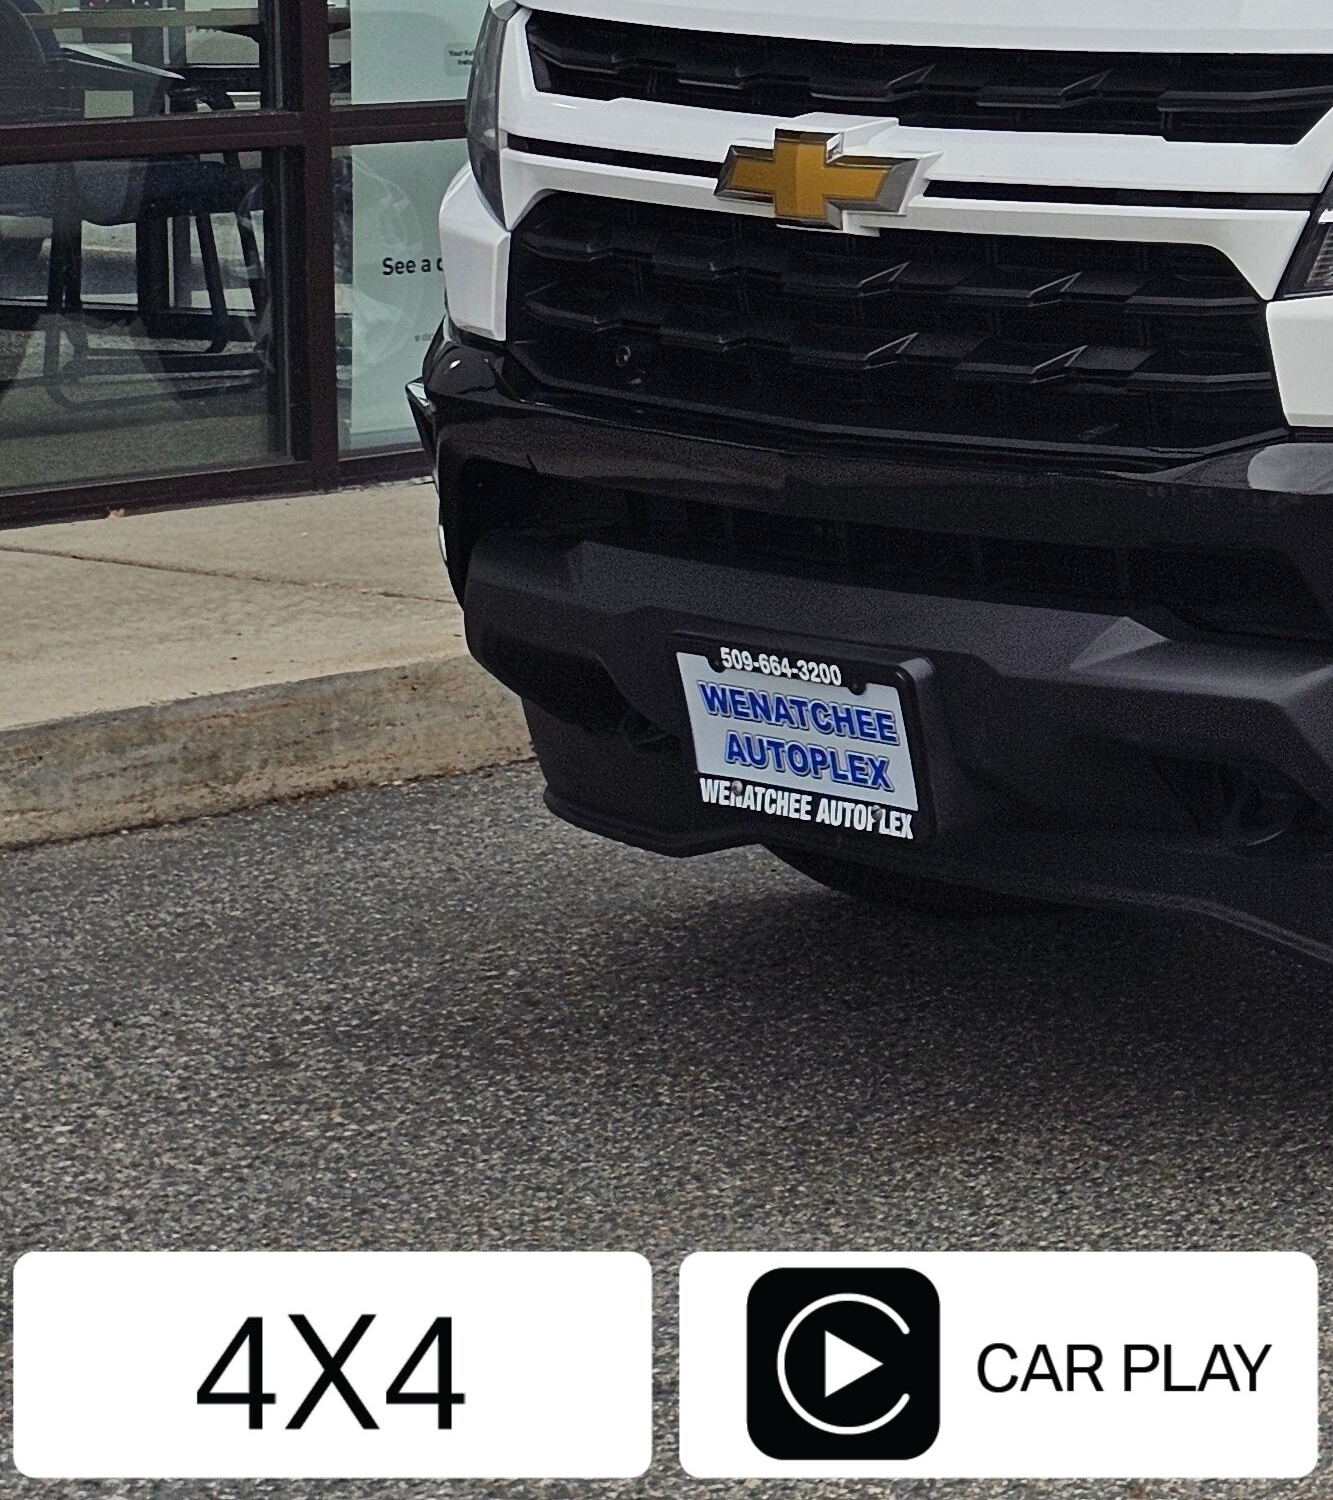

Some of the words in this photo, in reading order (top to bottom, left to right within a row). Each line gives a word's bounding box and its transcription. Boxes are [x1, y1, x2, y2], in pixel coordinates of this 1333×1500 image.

[382, 257, 417, 276] See
[421, 258, 431, 273] a
[720, 647, 842, 686] 509-664-3200
[698, 680, 900, 746] WENATCHEE
[725, 730, 895, 791] AUTOPLEX
